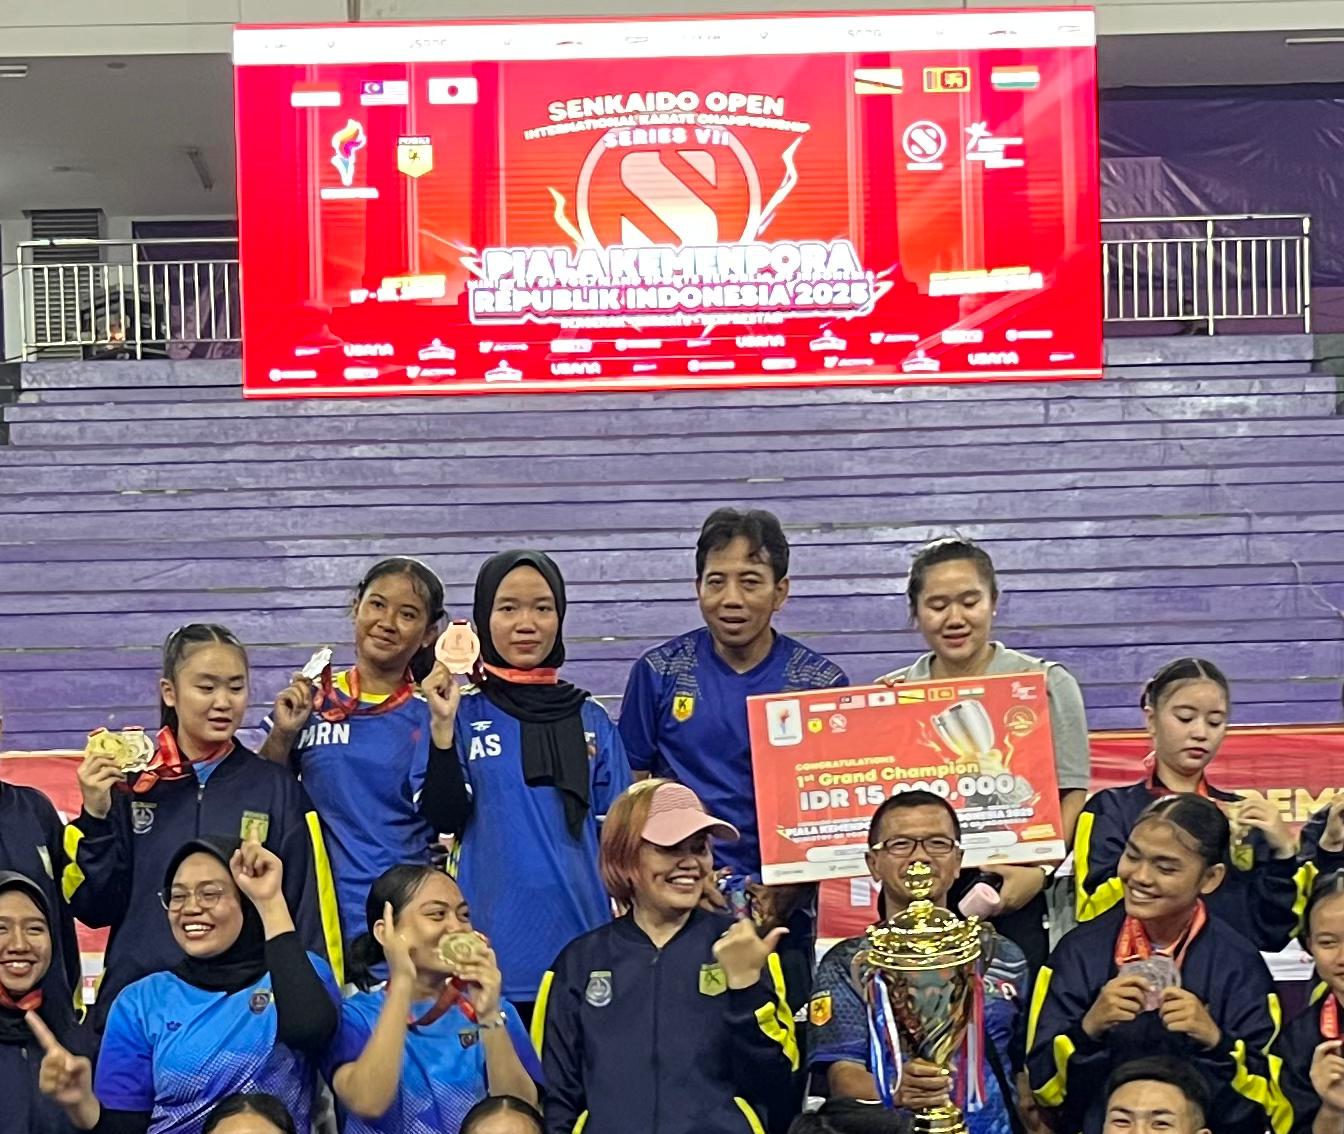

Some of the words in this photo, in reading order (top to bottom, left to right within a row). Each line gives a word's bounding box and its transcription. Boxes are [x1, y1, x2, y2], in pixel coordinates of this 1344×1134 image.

[548, 91, 699, 122] SENKAIDO
[705, 91, 785, 117] OPEN
[602, 127, 687, 148] SERIES
[694, 127, 729, 146] VII
[485, 247, 608, 281] PIALA
[607, 242, 861, 279] KEMENPORA
[473, 286, 624, 313] REPUBLIK
[626, 283, 792, 310] INDONESIA
[794, 280, 871, 307] 2025
[298, 723, 350, 750] MRN
[469, 735, 502, 761] AS
[818, 768, 877, 786] Grand
[881, 760, 980, 781] Champion
[799, 788, 850, 811] IDR
